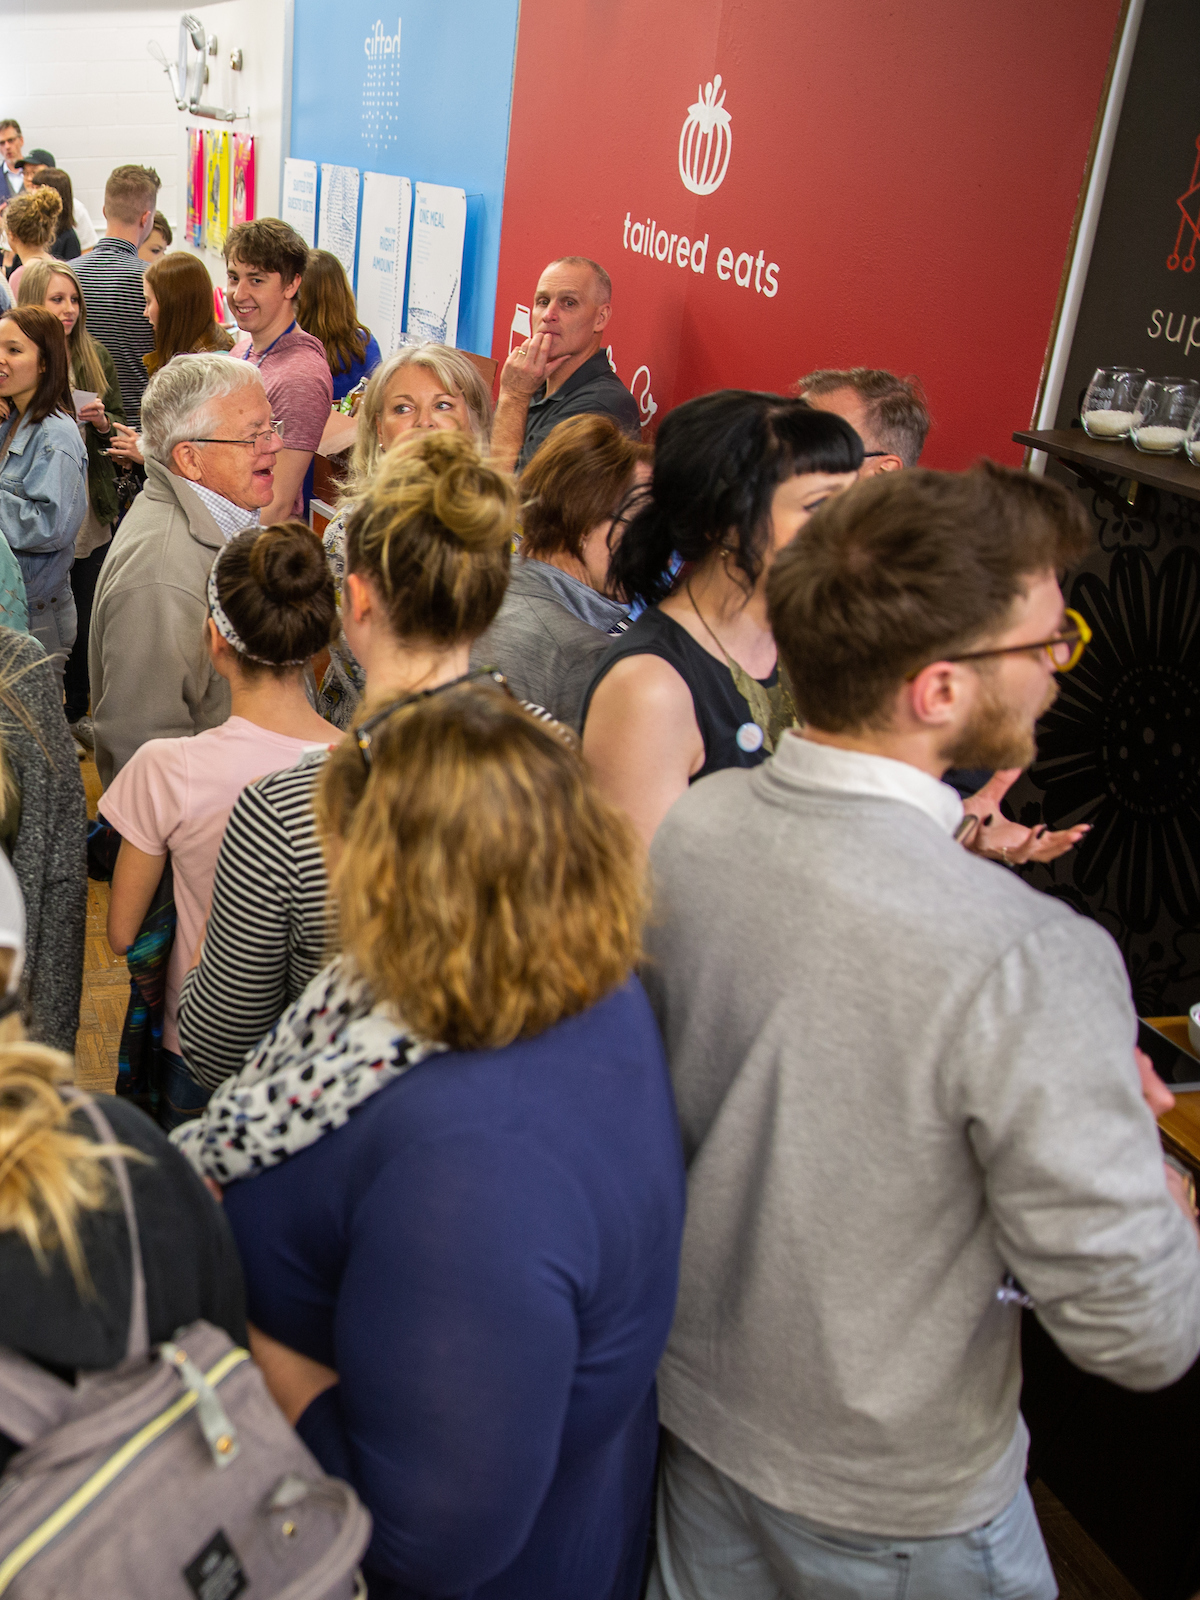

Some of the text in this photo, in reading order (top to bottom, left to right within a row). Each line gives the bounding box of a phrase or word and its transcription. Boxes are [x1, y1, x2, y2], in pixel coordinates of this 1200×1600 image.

[419, 208, 446, 229] ONE MEAL
[379, 236, 396, 253] RIGHT
[623, 212, 780, 298] tailored eats
[372, 256, 395, 274] AMOUNT
